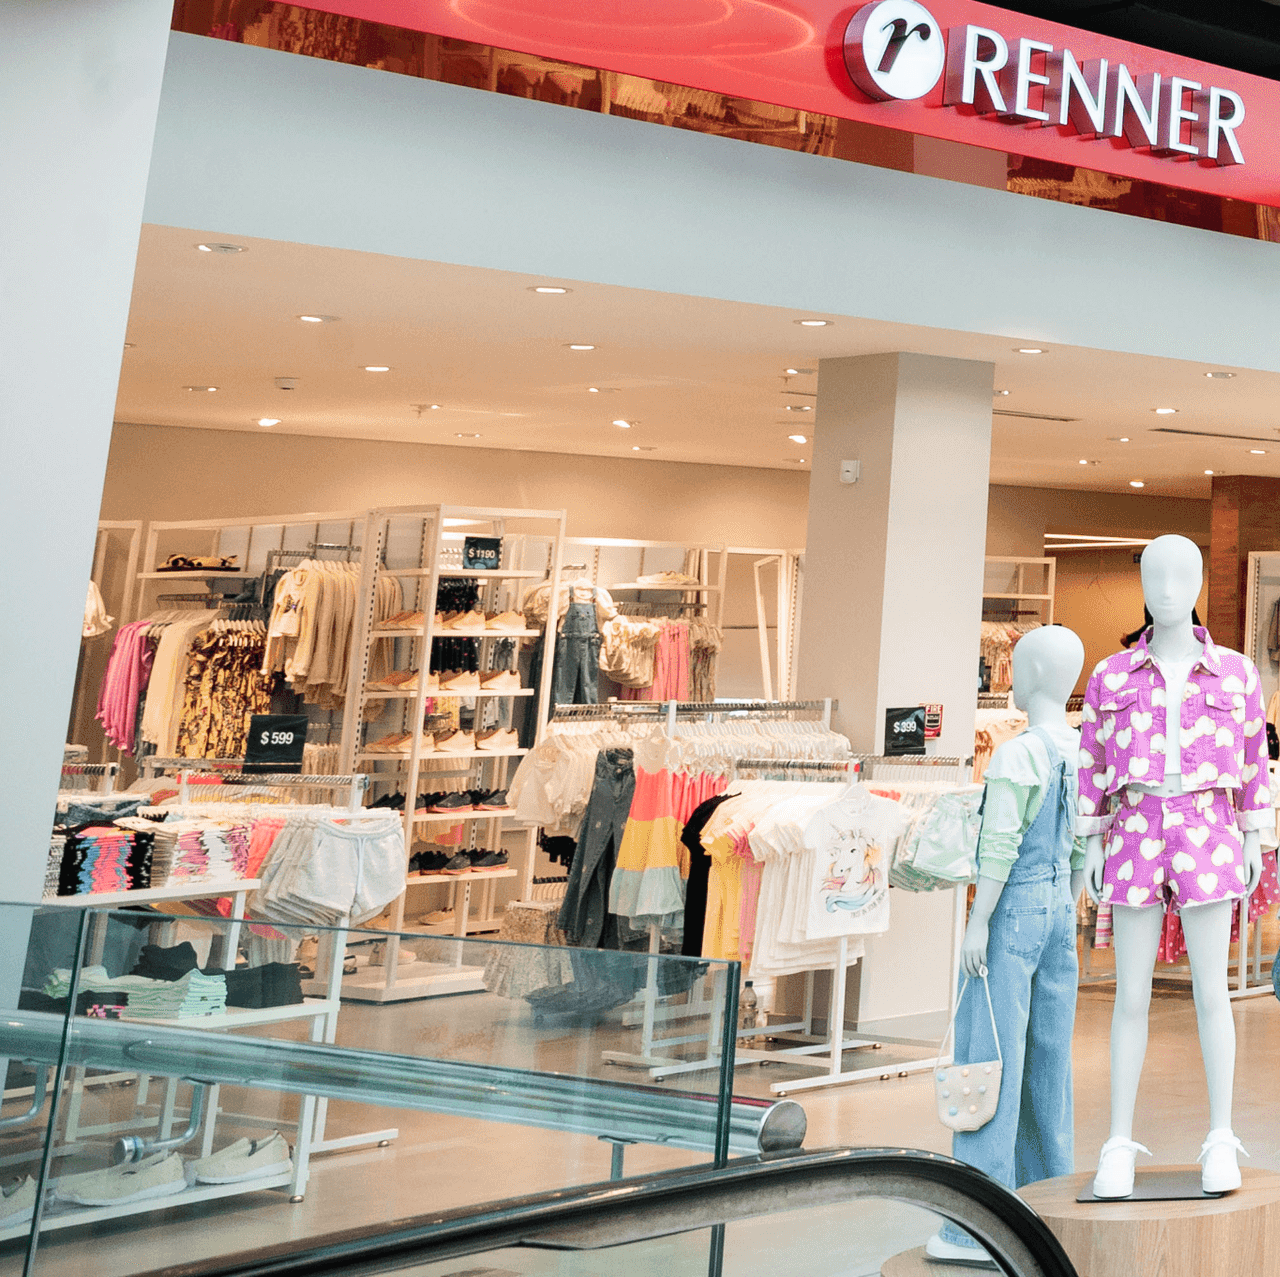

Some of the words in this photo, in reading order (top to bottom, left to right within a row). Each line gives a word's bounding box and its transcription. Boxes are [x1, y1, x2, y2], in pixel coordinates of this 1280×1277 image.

[961, 23, 1246, 165] RENNER
[901, 721, 917, 733] 399
[271, 731, 295, 745] 599
